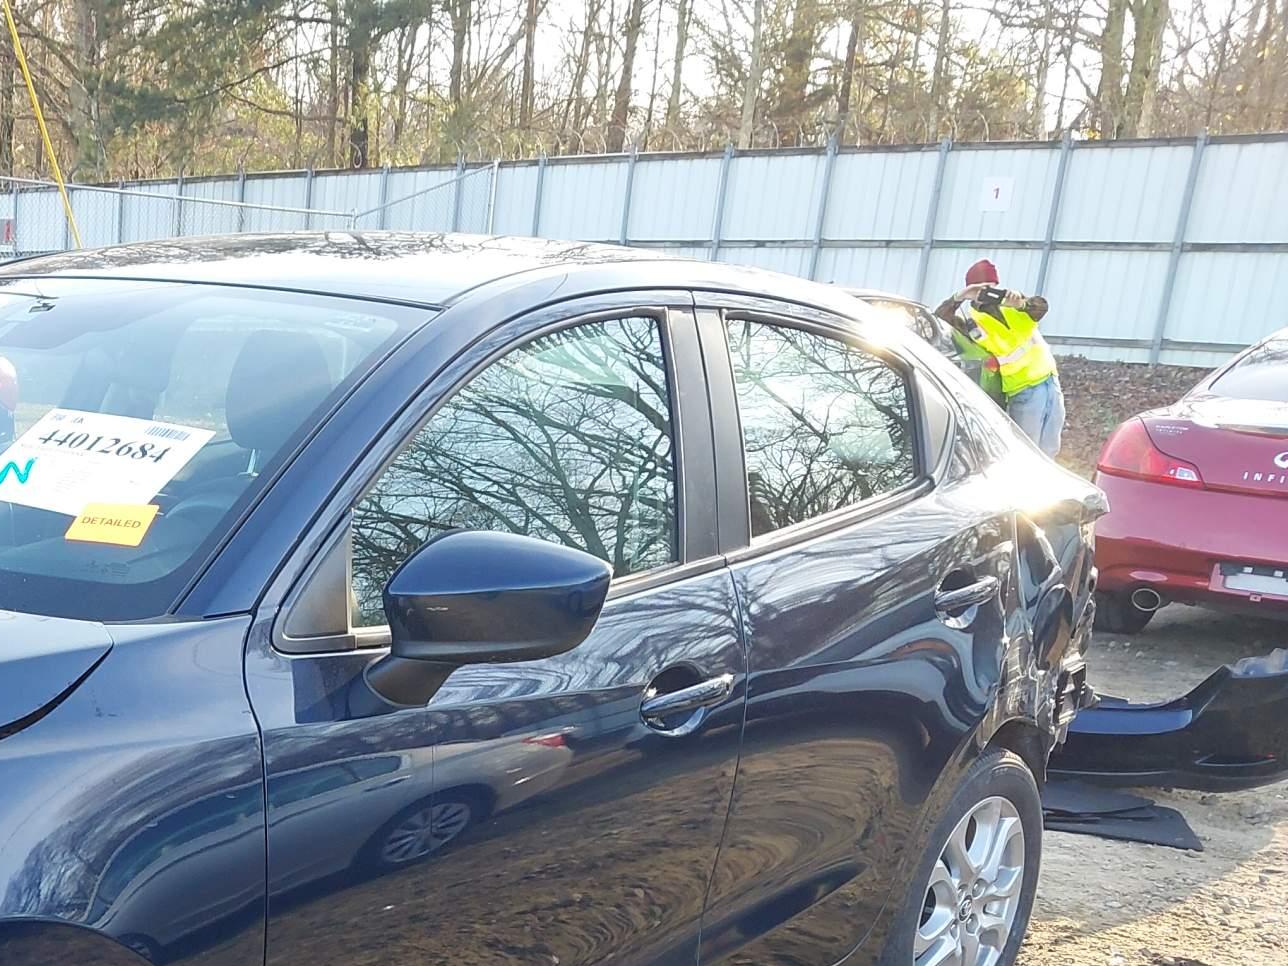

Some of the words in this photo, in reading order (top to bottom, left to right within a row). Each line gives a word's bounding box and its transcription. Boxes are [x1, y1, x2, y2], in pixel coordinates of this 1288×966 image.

[993, 187, 1000, 199] 1
[38, 429, 171, 463] 44012684
[81, 516, 141, 529] DETAILED
